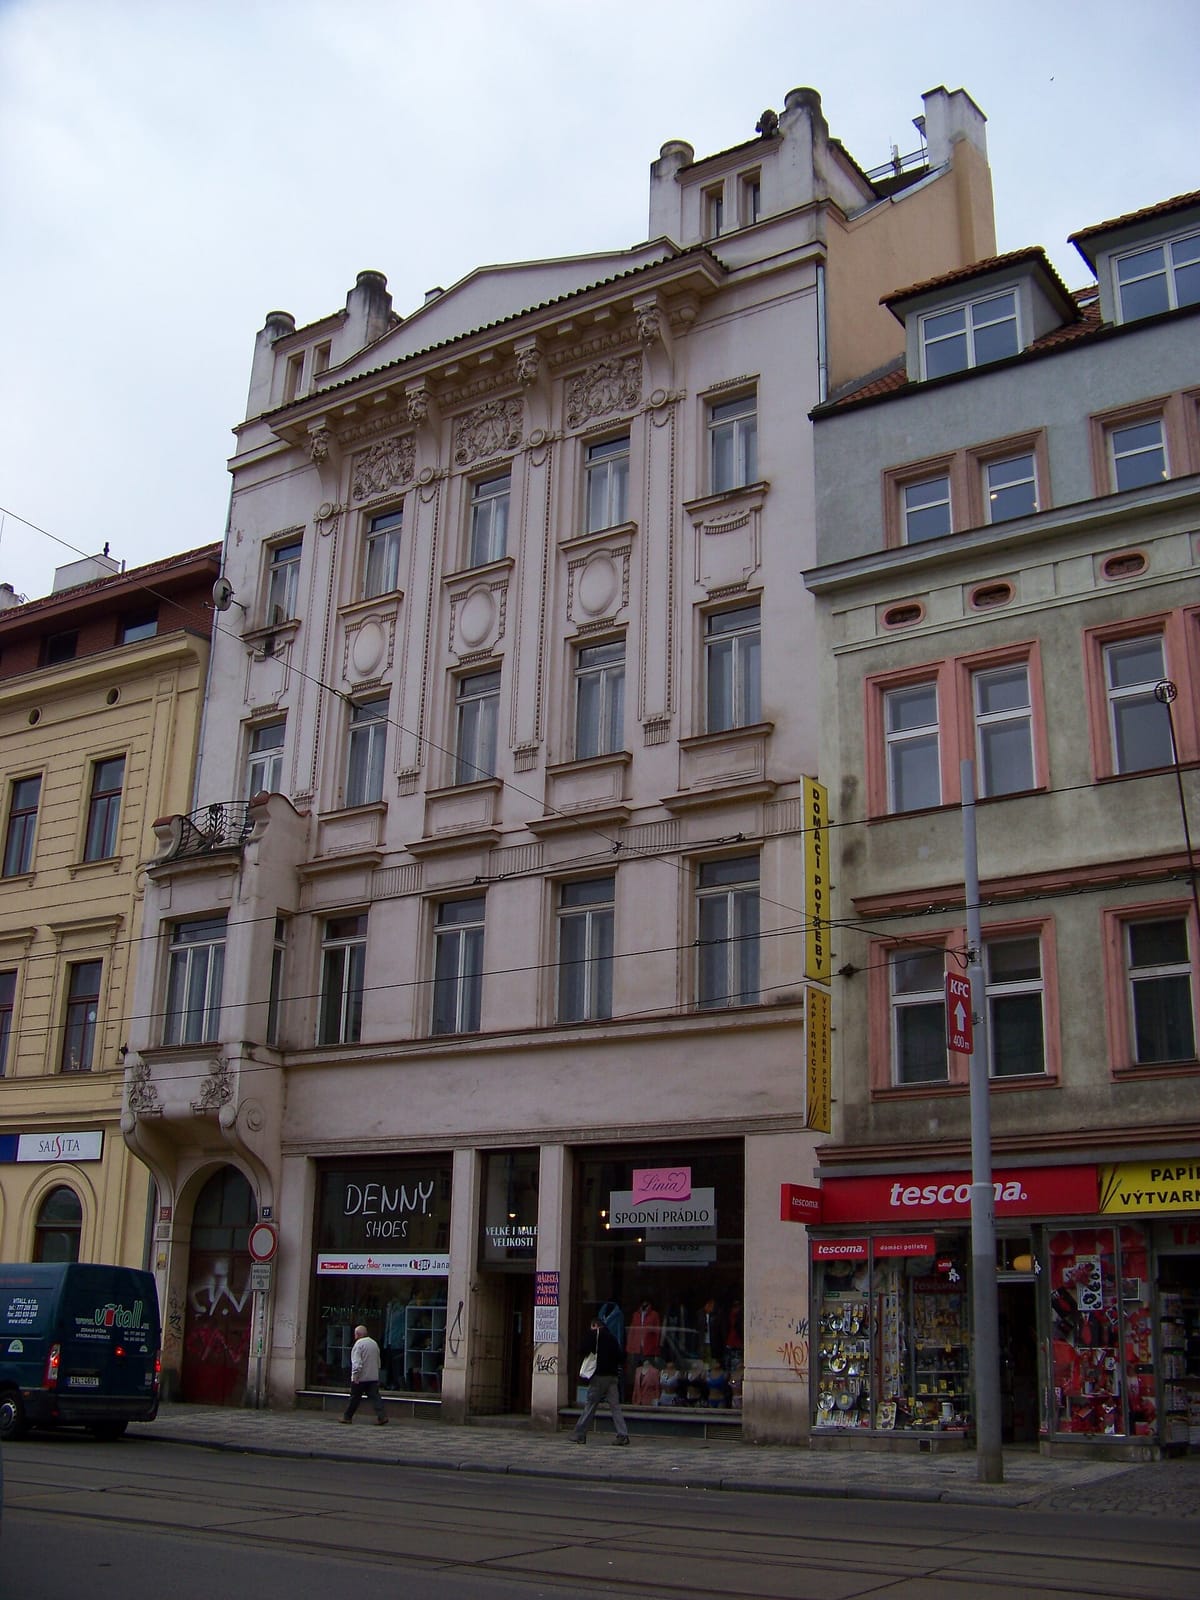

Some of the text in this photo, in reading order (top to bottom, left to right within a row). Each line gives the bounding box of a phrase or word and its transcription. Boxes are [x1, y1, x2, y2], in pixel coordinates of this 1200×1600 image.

[950, 979, 969, 998] KFC
[953, 1034, 964, 1048] 400
[38, 1135, 80, 1159] SALSITA
[343, 1181, 434, 1215] DENNY
[889, 1181, 1027, 1206] tescoa.
[263, 1208, 270, 1216] 27
[615, 1207, 709, 1224] SPODNÍ PRÁDLO
[365, 1220, 409, 1238] SHOES
[486, 1224, 510, 1236] VELKÉ
[492, 1237, 534, 1247] VELIKOSTI
[349, 1262, 366, 1270] Gabor
[432, 1260, 450, 1269] Jana
